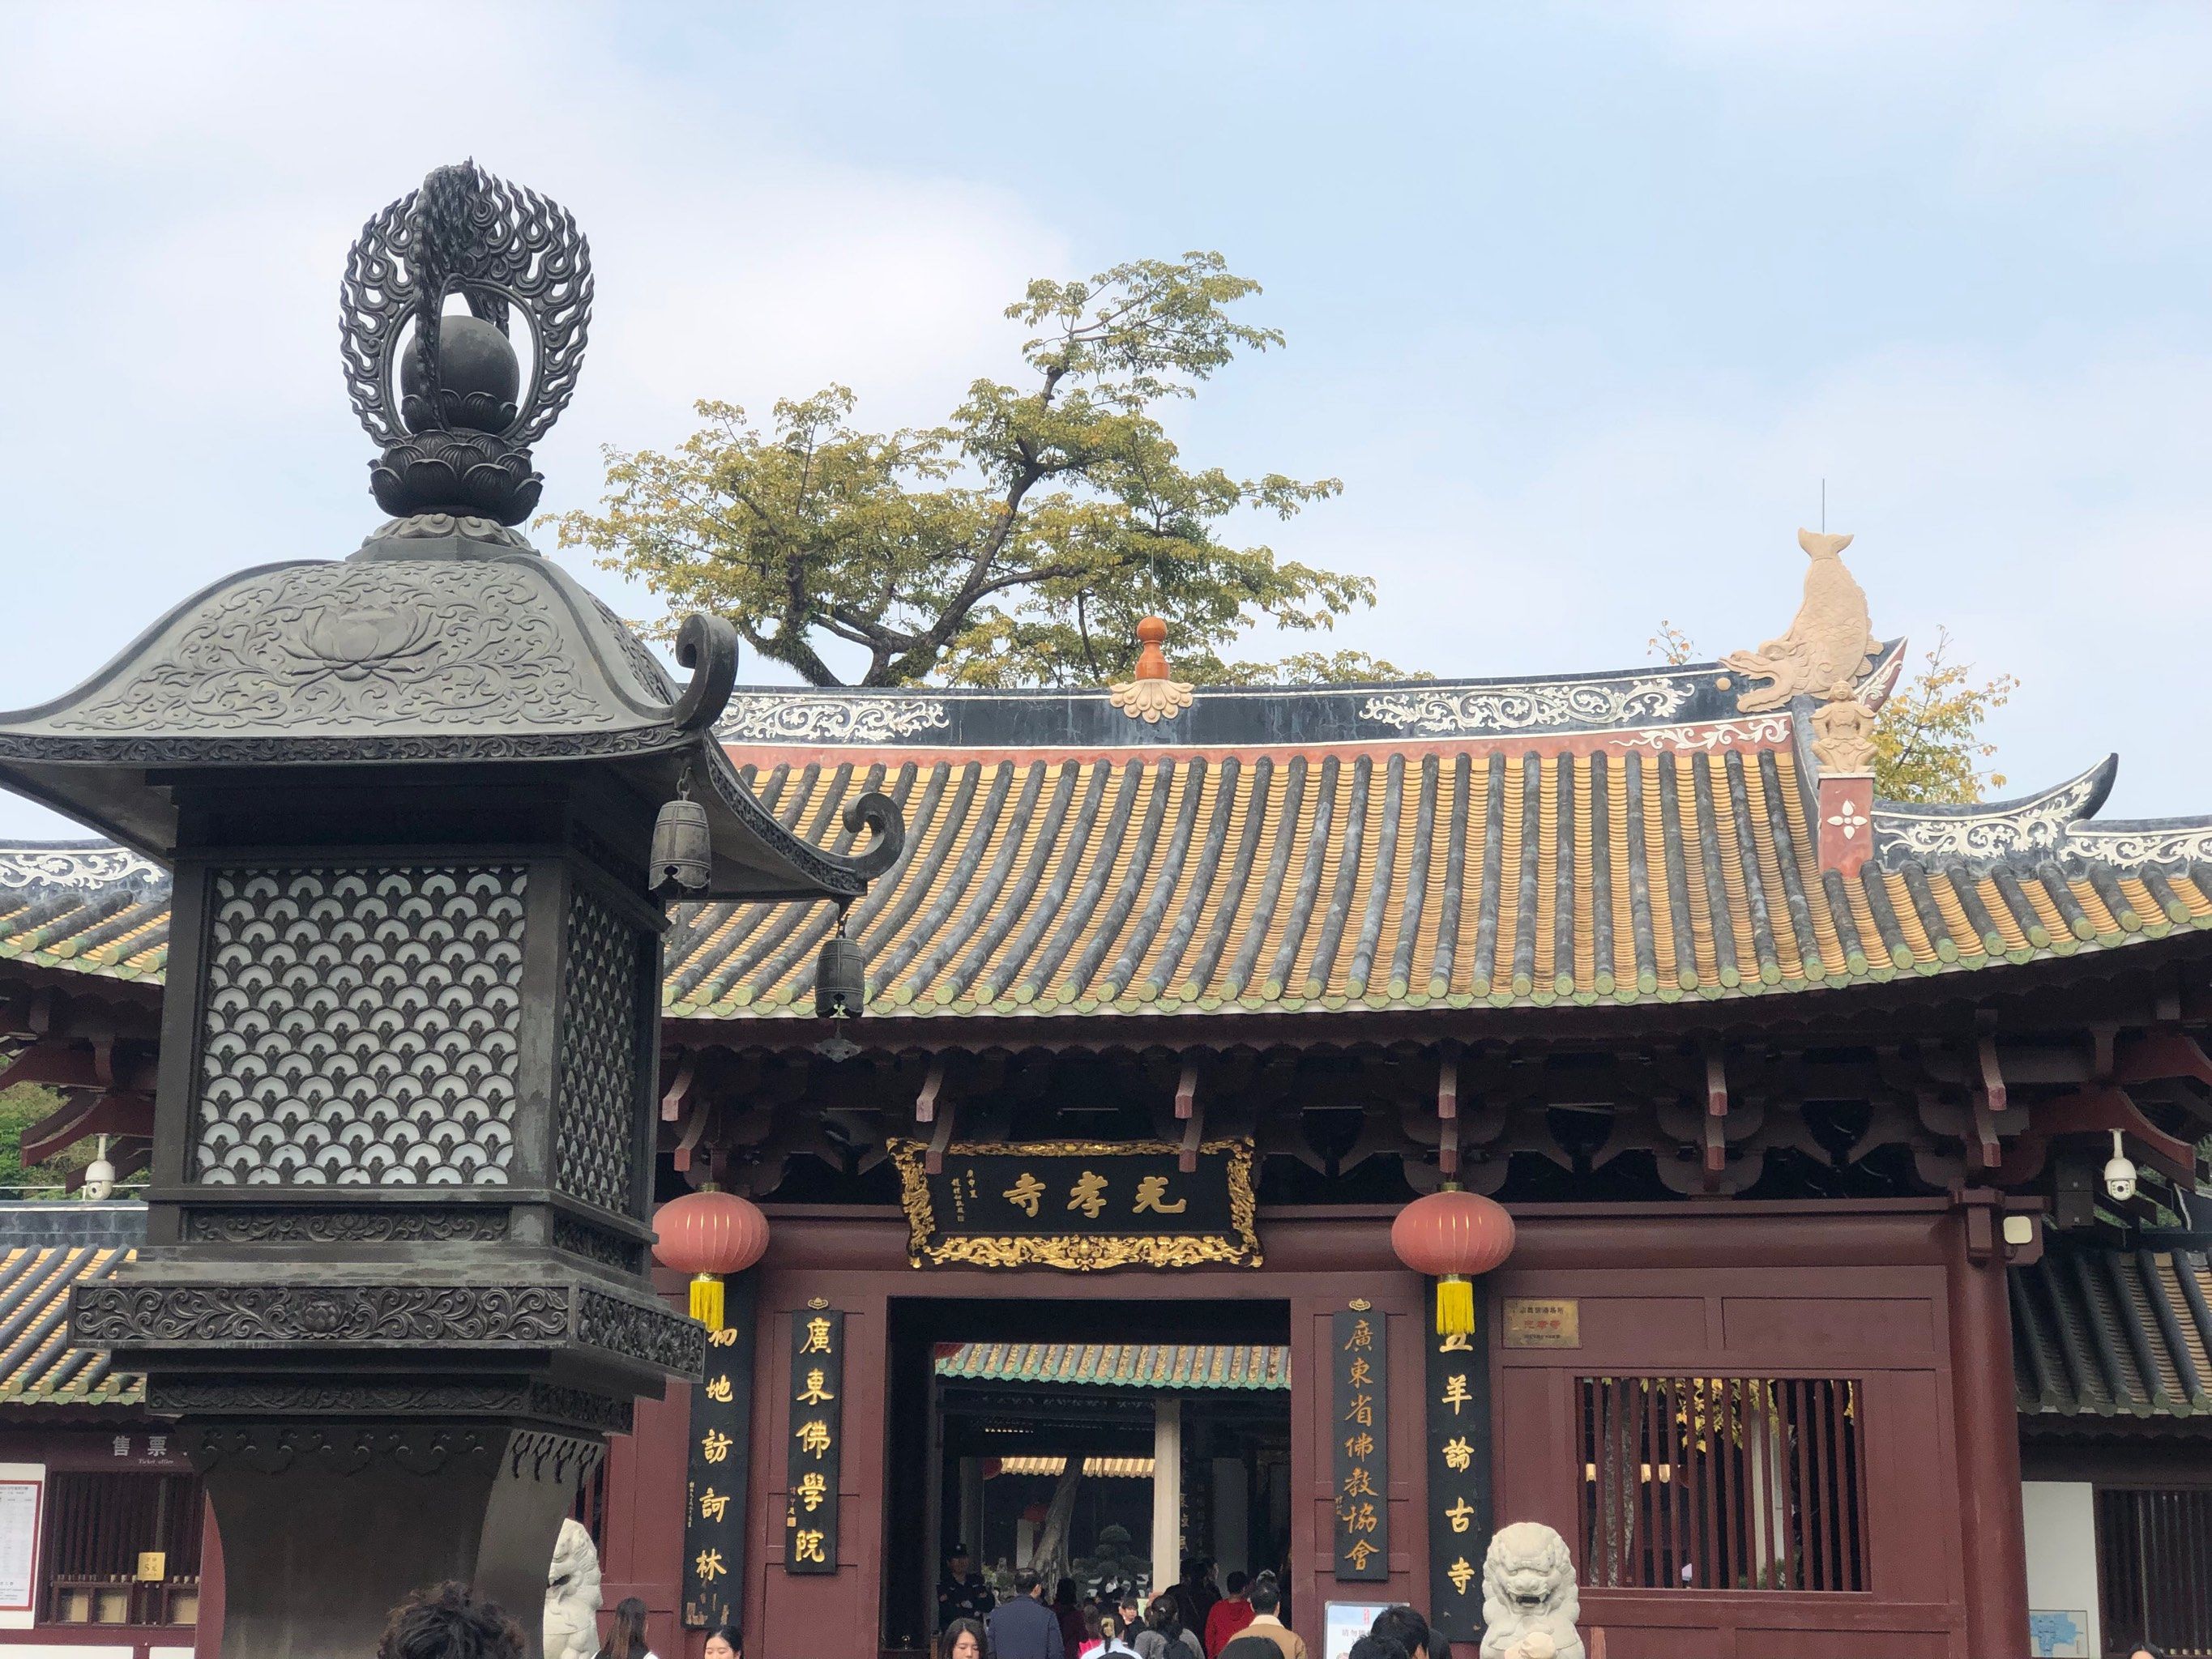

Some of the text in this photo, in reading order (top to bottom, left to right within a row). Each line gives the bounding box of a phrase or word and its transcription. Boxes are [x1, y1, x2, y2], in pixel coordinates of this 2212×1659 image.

[1002, 1171, 1187, 1218] 光孝寺
[113, 1435, 167, 1456] 售票
[796, 1316, 834, 1563] 廣東佛學院
[1343, 1319, 1379, 1571] 廣東省佛教協會
